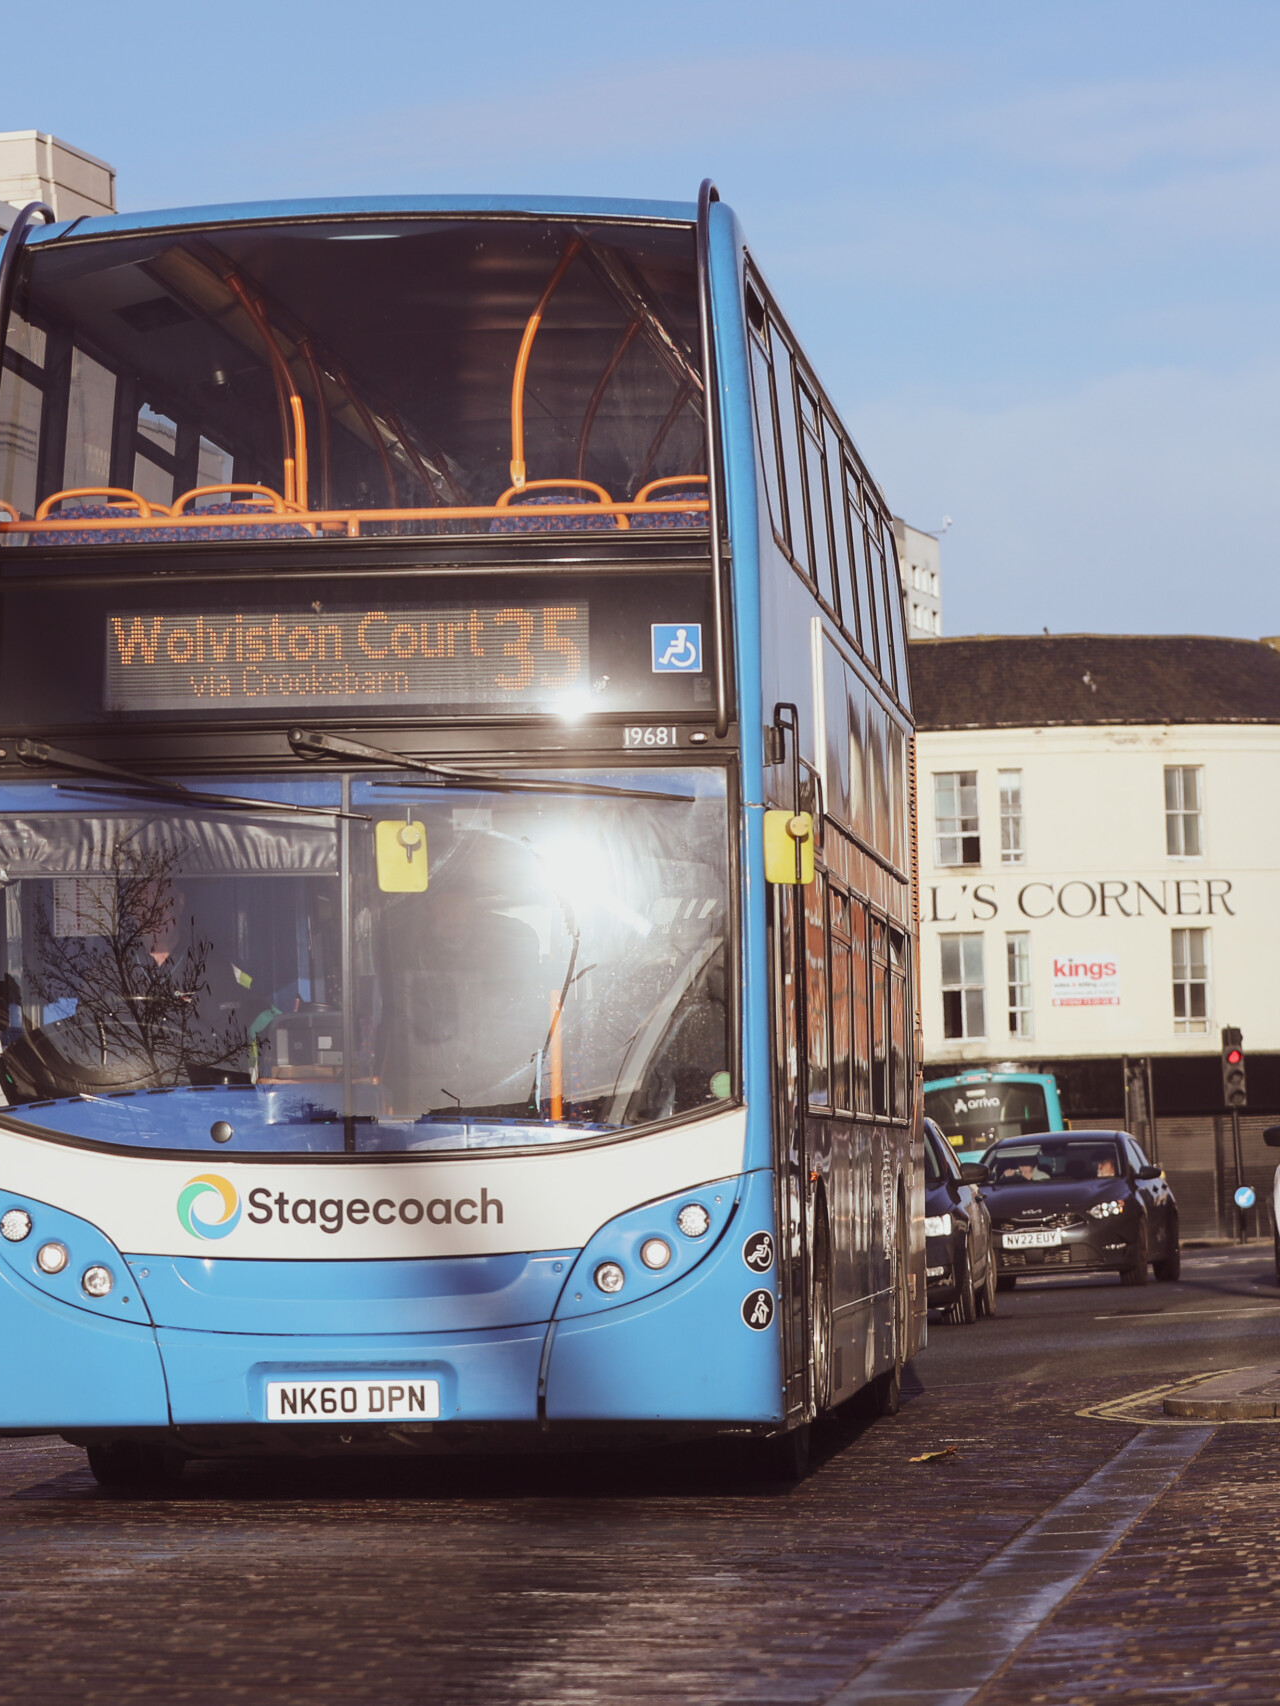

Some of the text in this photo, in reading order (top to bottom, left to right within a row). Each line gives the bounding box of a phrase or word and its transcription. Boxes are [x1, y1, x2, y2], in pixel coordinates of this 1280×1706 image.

[110, 609, 485, 664] Wolviston Court
[493, 607, 581, 690] 35
[189, 664, 410, 697] via Crooksbarn
[624, 726, 677, 746] 19681
[920, 878, 1236, 921] L'S CORNER
[1053, 958, 1117, 981] kings
[967, 1096, 1000, 1110] arriva
[247, 1187, 504, 1234] Stagecoach
[1006, 1232, 1057, 1246] NV22 EUY
[280, 1385, 426, 1414] NK60 DPN
